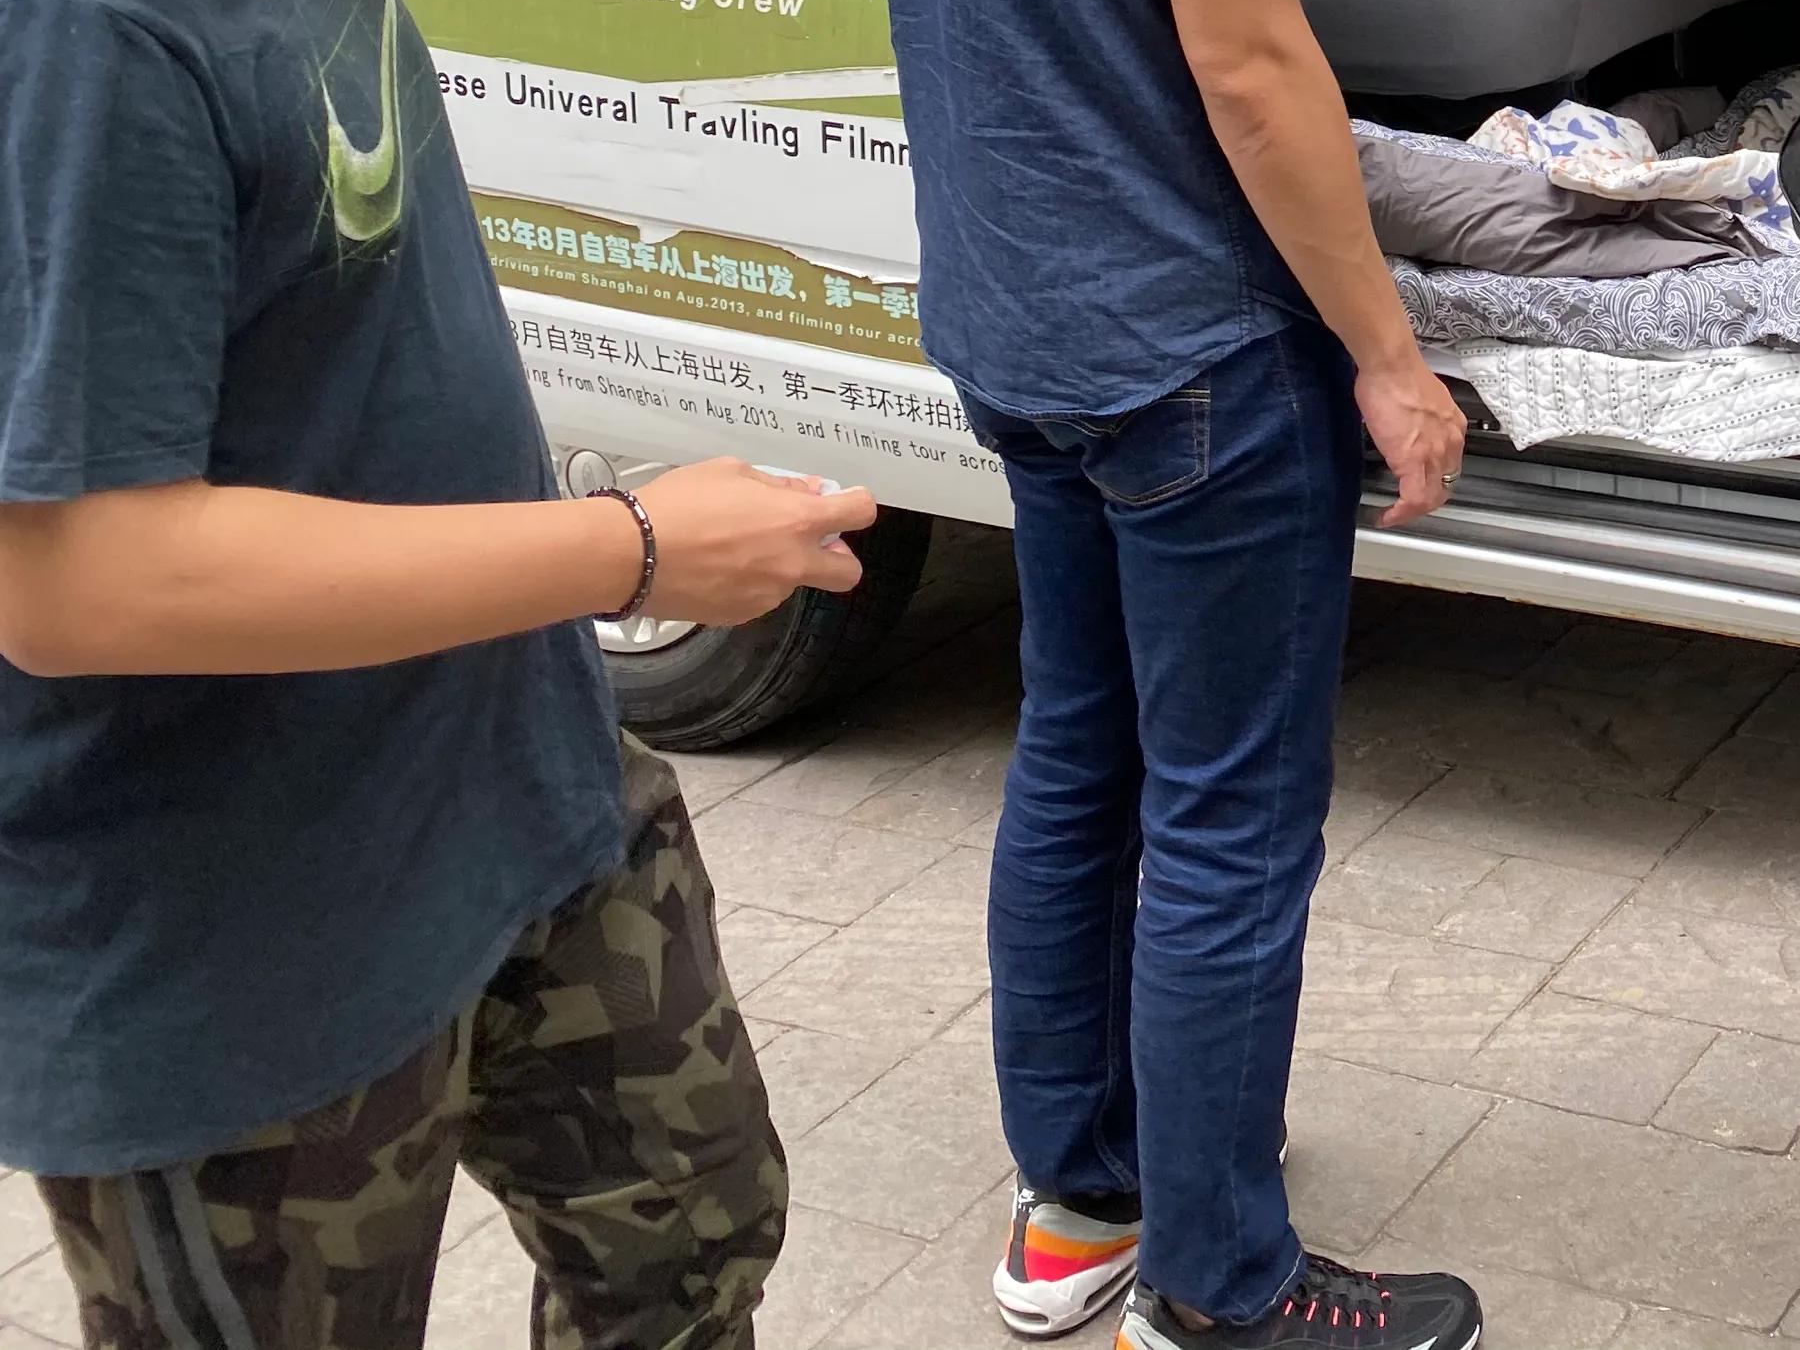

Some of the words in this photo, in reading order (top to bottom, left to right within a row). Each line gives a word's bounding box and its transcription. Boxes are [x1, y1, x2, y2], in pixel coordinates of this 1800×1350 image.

[505, 71, 638, 125] Univeral
[659, 96, 799, 158] Travling
[491, 254, 539, 277] driving
[544, 265, 577, 282] from
[582, 273, 649, 296] Shanghai
[654, 288, 671, 300] on
[756, 307, 783, 323] and
[789, 312, 844, 336] filming
[849, 322, 881, 340] tour
[558, 368, 594, 392] from
[599, 375, 670, 408] Shanghai
[679, 397, 698, 413] on
[798, 420, 825, 440] and
[834, 424, 902, 457] filming
[910, 441, 947, 463] tour
